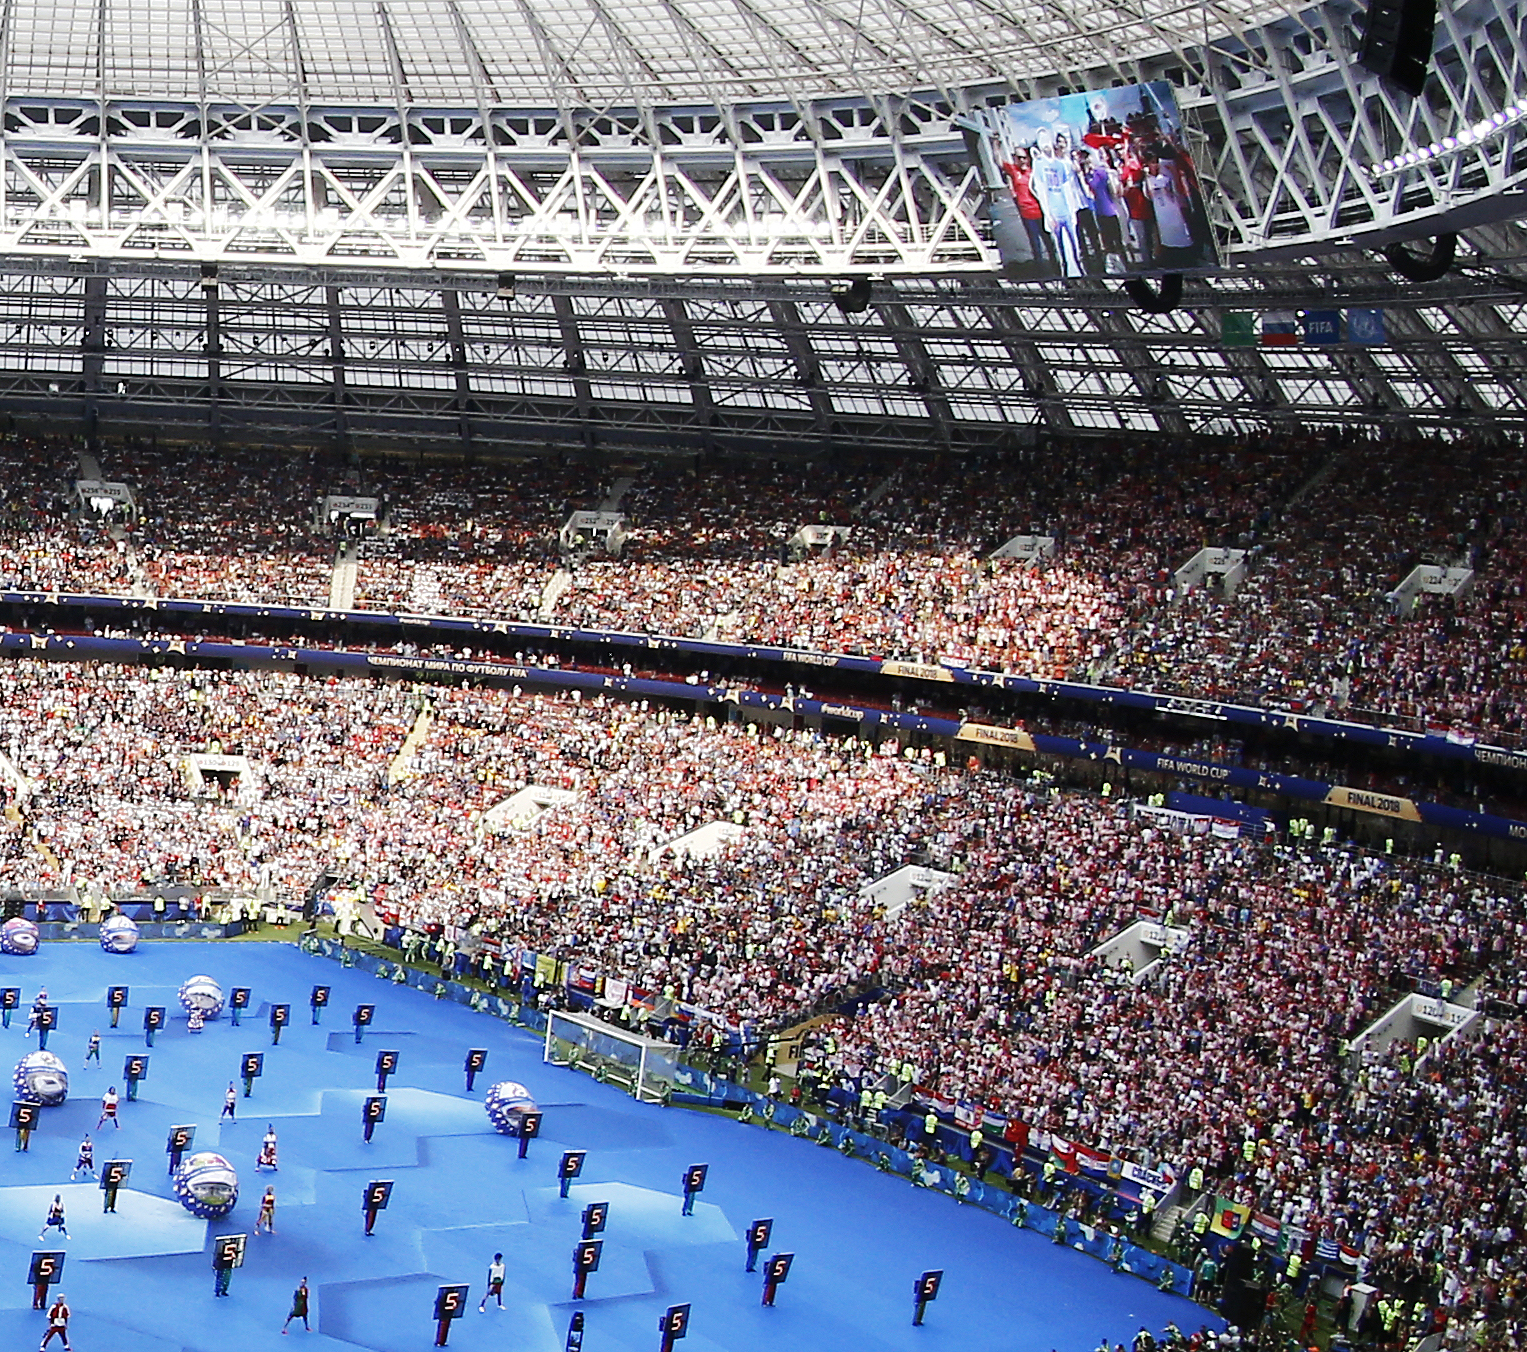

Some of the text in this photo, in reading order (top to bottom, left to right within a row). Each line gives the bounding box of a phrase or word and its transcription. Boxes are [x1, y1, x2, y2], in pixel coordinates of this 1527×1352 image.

[1308, 321, 1333, 334] FIFA
[367, 655, 527, 679] ЧЕМПИОНАТ МИРА ПО ФУТБОЛУ FIFA
[898, 664, 937, 679] FINAL 2018
[976, 728, 1018, 744] FINAL 2018
[1157, 757, 1228, 780] FIFA WORLD CUP
[1348, 792, 1400, 813] FINAL 2018
[248, 1058, 257, 1071] 5
[567, 1157, 578, 1170] 5
[110, 1167, 123, 1182] 5
[373, 1188, 385, 1202] 5
[40, 1259, 55, 1275] 5
[774, 1261, 786, 1275] 5
[924, 1278, 935, 1293] 5
[445, 1293, 459, 1309] 5
[672, 1313, 682, 1330] 5
